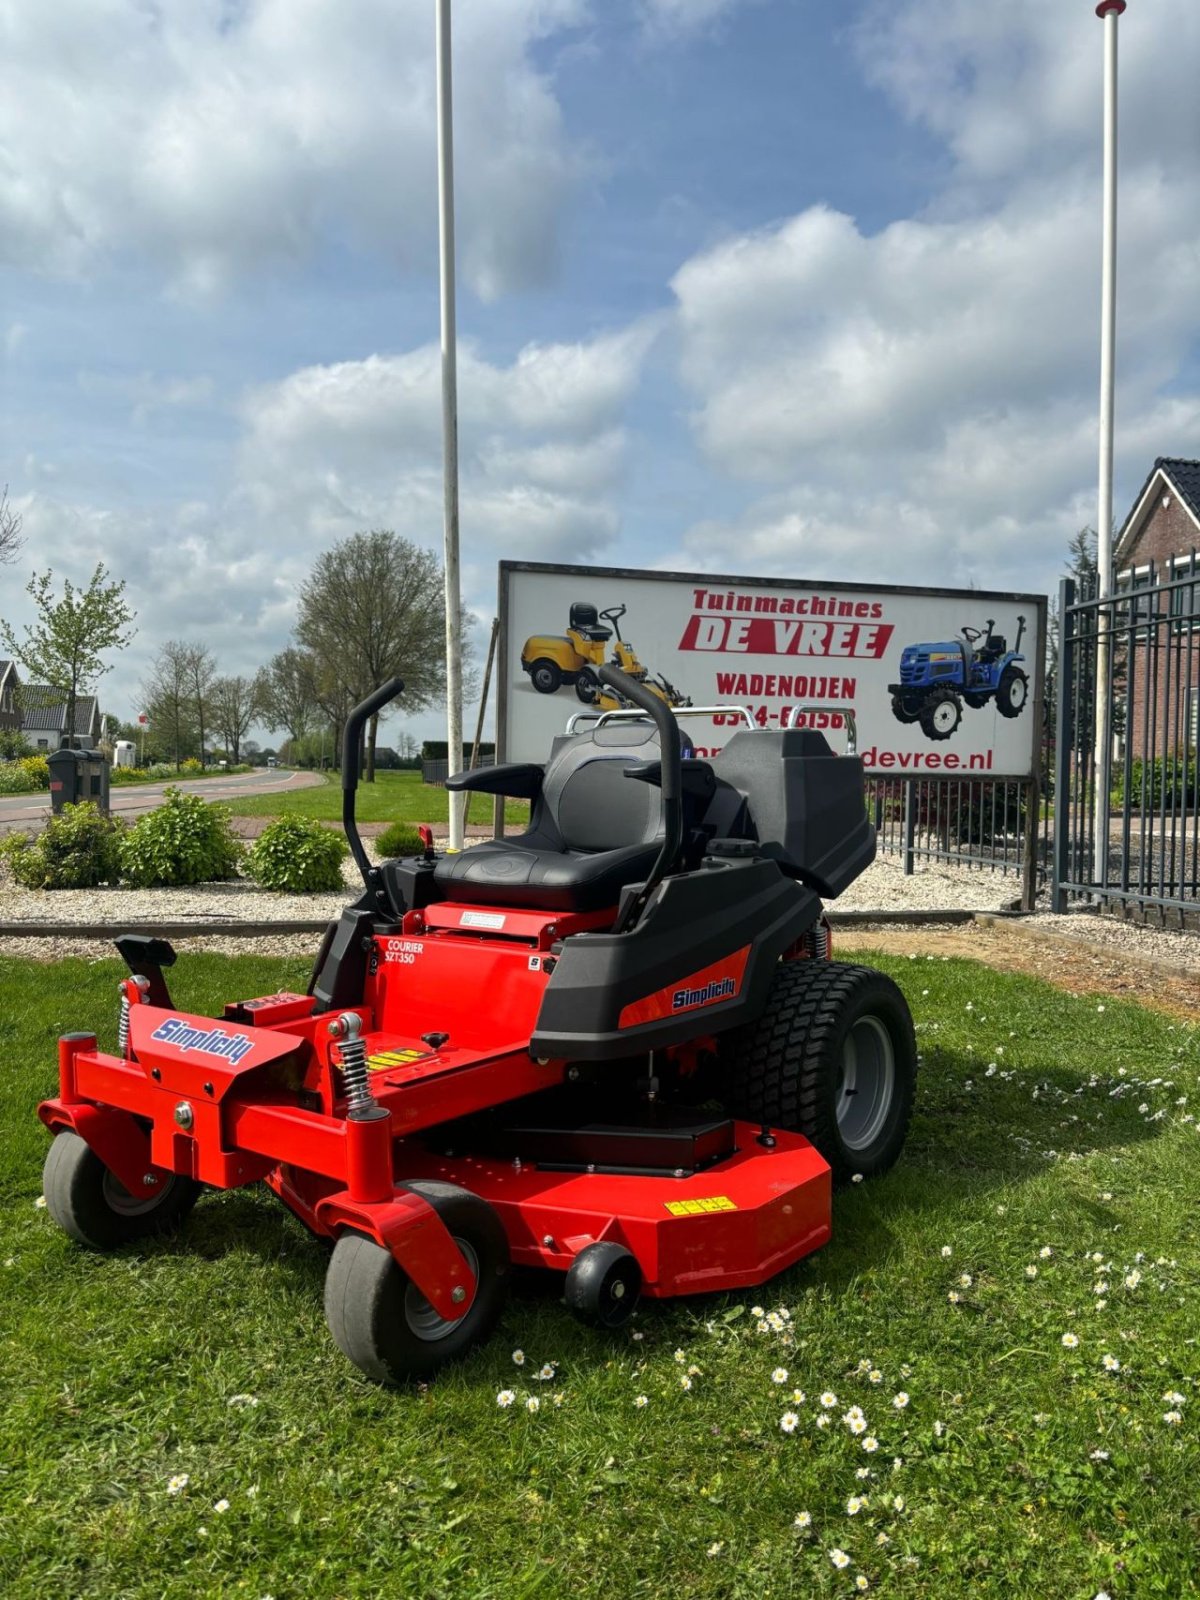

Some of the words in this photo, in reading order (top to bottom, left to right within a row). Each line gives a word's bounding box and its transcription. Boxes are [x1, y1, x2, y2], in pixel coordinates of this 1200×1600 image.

[693, 589, 883, 618] Tuinmachines
[694, 617, 752, 652] DE
[773, 620, 880, 657] VREE
[716, 673, 857, 699] WADENOIJEN
[385, 951, 415, 964] SZT350
[387, 940, 424, 954] COURIER
[673, 977, 736, 1010] Simplicity
[151, 1017, 255, 1065] Simplicity
